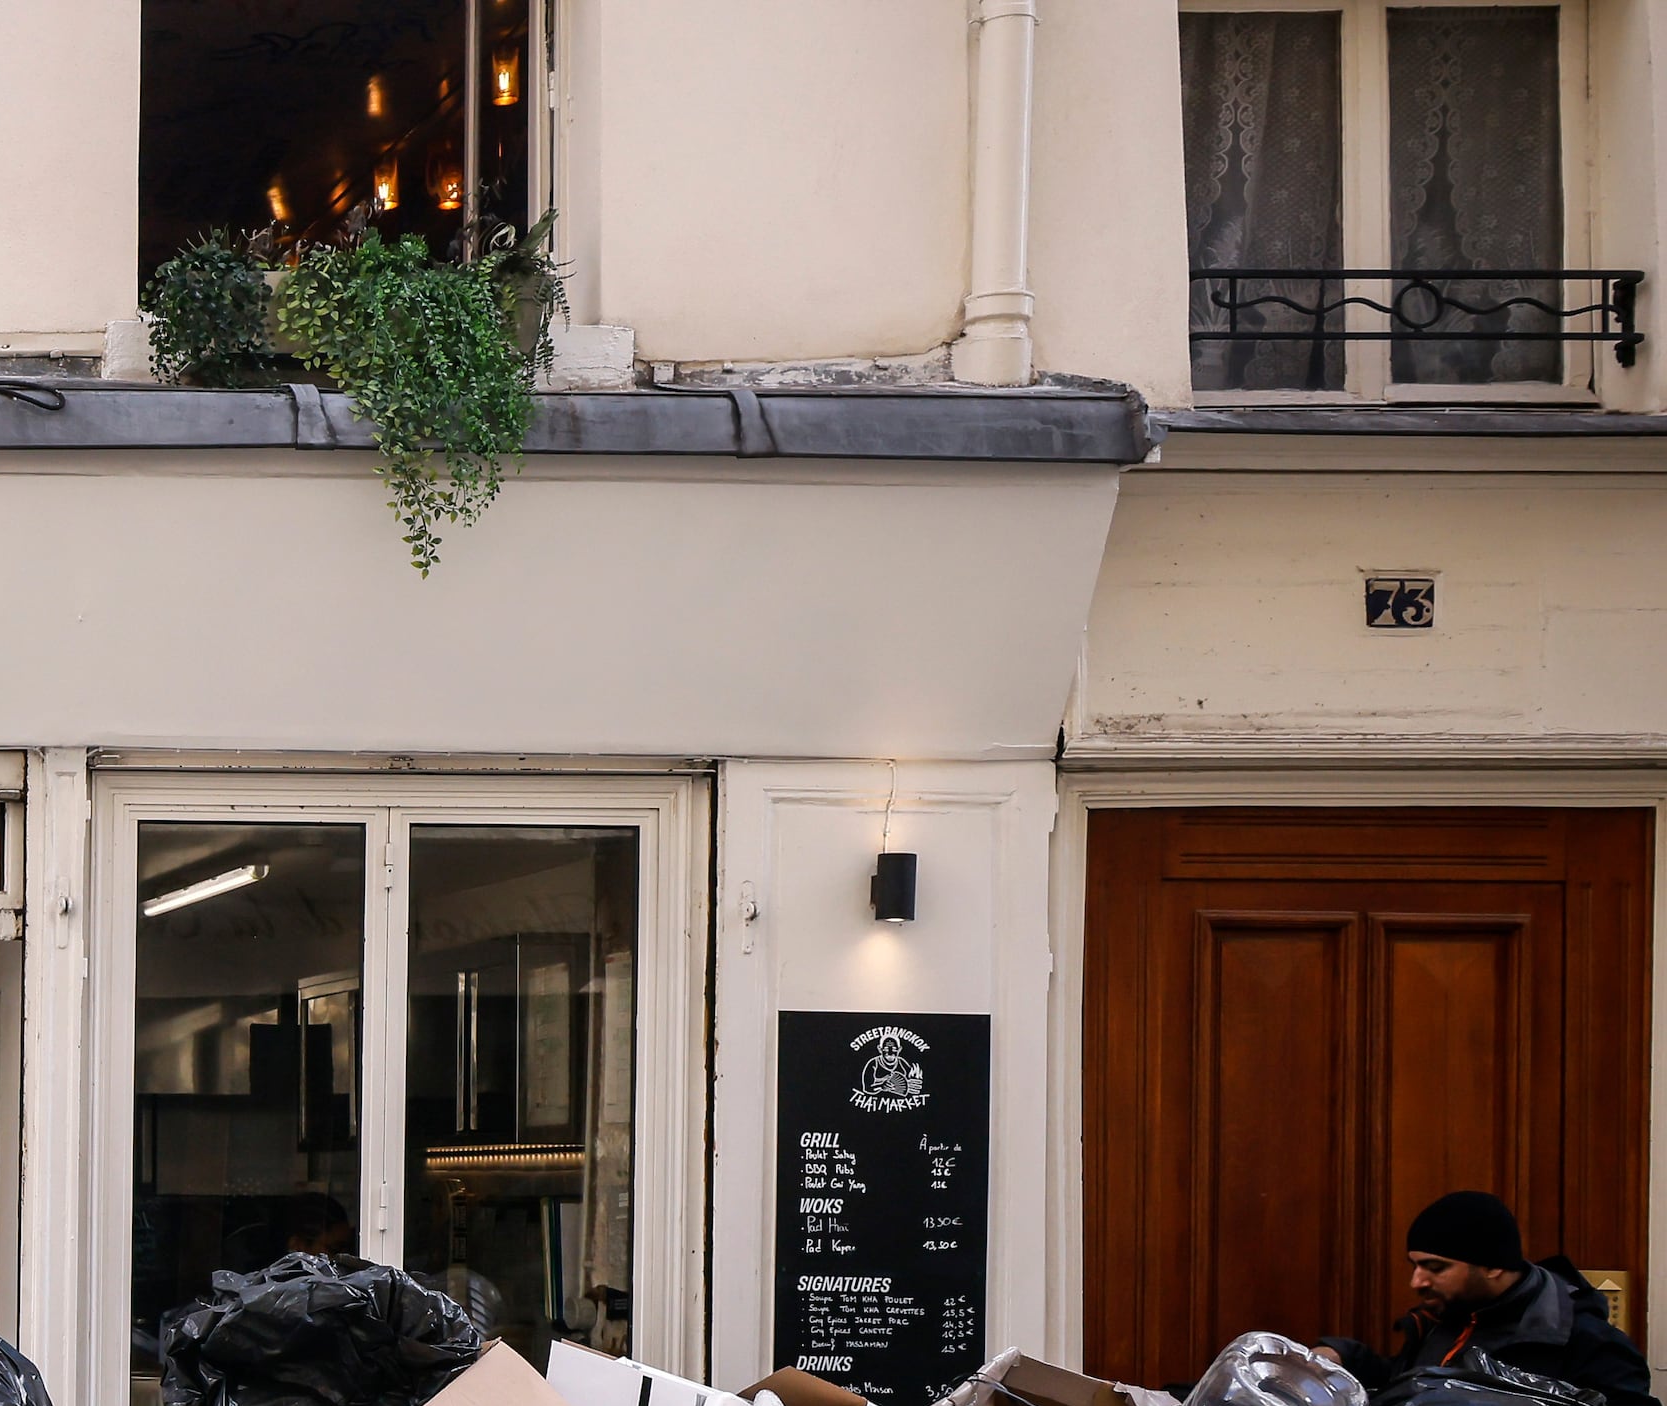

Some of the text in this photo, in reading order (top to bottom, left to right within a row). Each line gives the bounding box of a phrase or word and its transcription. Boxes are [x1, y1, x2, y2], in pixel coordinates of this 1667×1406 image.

[1369, 581, 1433, 625] 73
[878, 1094, 930, 1113] MARKET
[800, 1132, 839, 1148] GRILL
[805, 1163, 827, 1175] BBQ
[836, 1164, 854, 1175] Ribs
[800, 1198, 844, 1214] WOKS
[807, 1215, 823, 1233] Pad
[806, 1239, 822, 1253] Pad
[797, 1276, 891, 1293] SIGNATURES
[885, 1296, 914, 1305] POULET
[888, 1317, 910, 1325] PORC
[796, 1355, 854, 1372] DRINKS
